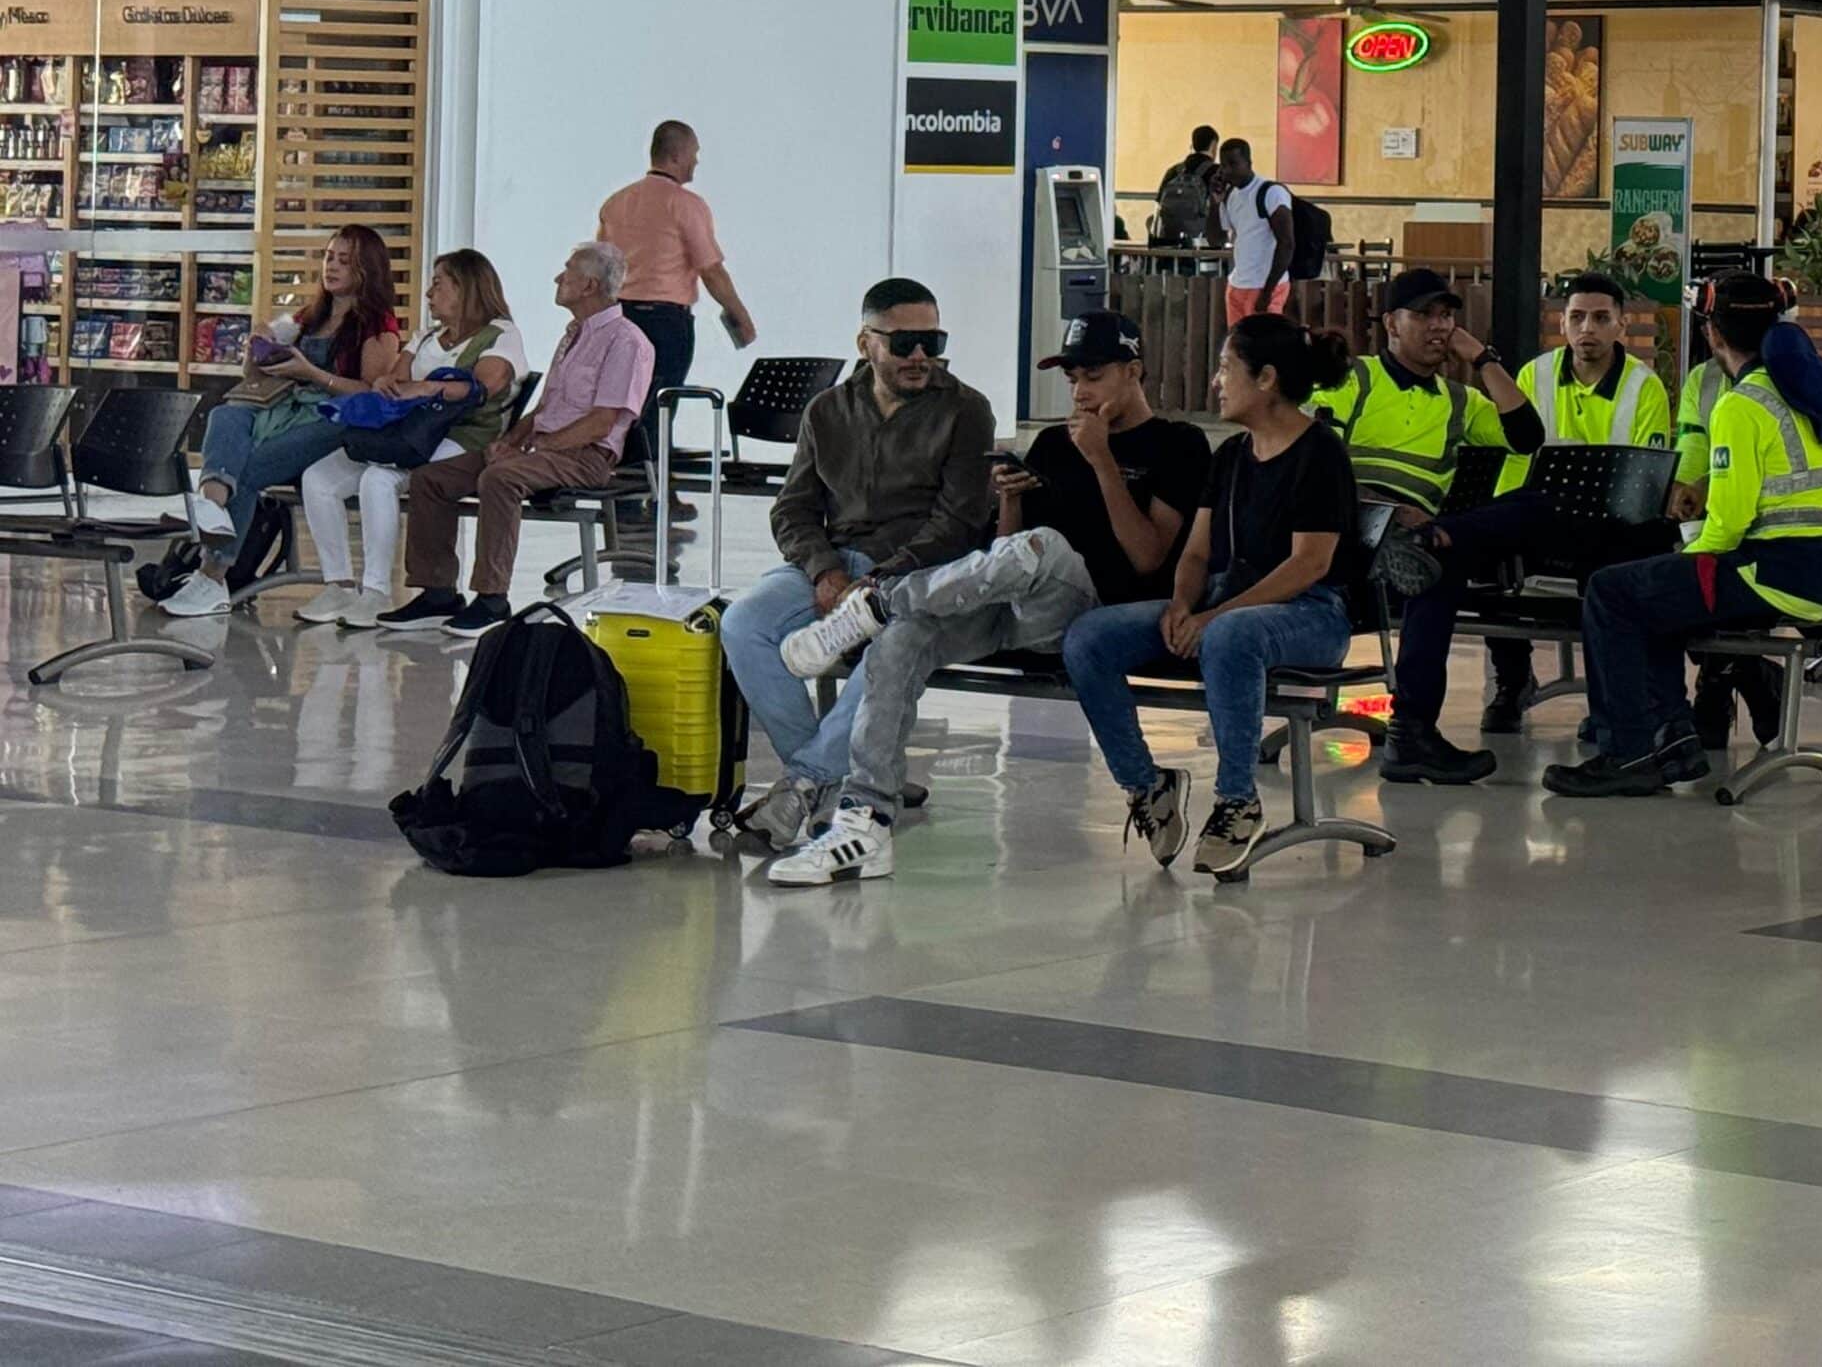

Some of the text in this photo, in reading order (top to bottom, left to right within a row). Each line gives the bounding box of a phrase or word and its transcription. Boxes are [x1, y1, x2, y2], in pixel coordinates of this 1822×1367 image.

[1355, 34, 1417, 61] OPEN
[1618, 135, 1685, 152] SUBWAY
[1615, 189, 1683, 214] RANCHERO
